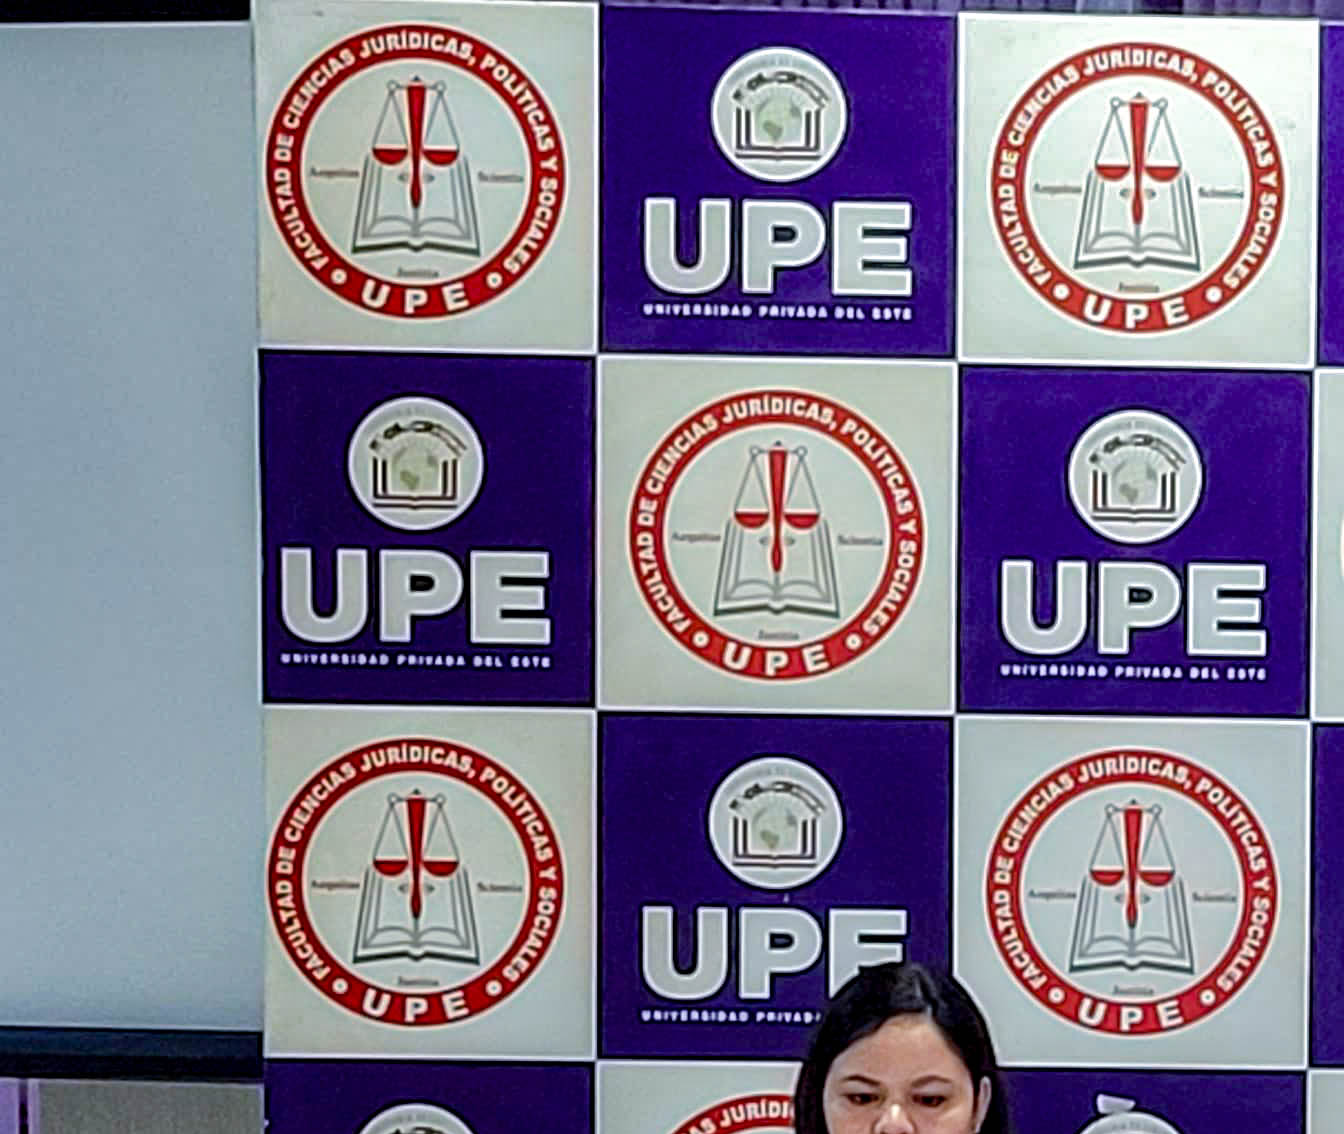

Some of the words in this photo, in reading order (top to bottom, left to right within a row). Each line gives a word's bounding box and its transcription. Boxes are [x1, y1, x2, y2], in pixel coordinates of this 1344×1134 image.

[283, 49, 355, 128] CIENCIAS
[480, 54, 554, 151] POLÍTICAS
[1008, 65, 1080, 146] CIENCIAS
[1202, 70, 1274, 167] POLÍTICAS
[274, 134, 294, 161] DE
[541, 156, 557, 171] Y
[999, 149, 1019, 178] DE
[1260, 172, 1277, 187] Y
[274, 168, 328, 269] FACULTAD
[504, 178, 557, 273] SOCIALES
[646, 198, 911, 295] UPE
[999, 185, 1051, 285] FACULTAD
[1223, 192, 1277, 288] SOCIALES
[362, 280, 468, 313] UPE
[1084, 294, 1189, 328] UPE
[646, 414, 718, 494] CIENCIAS
[840, 419, 913, 514] POLÍTICAS
[637, 498, 657, 526] DE
[900, 519, 916, 533] Y
[282, 549, 550, 643] UPE
[637, 532, 691, 632] FACULTAD
[863, 540, 916, 635] SOCIALES
[1002, 561, 1266, 655] UPE
[724, 642, 829, 676] UPE
[285, 763, 356, 841] CIENCIAS
[480, 767, 553, 861] POLÍTICAS
[1003, 773, 1074, 852] CIENCIAS
[1195, 778, 1266, 872] POLÍTICAS
[276, 847, 296, 874] DE
[539, 867, 556, 880] Y
[994, 856, 1014, 884] DE
[1253, 876, 1270, 890] Y
[276, 880, 330, 979] FACULTAD
[503, 887, 556, 981] SOCIALES
[994, 890, 1047, 989] FACULTAD
[1217, 896, 1270, 991] SOCIALES
[363, 989, 468, 1022] UPE
[1079, 998, 1183, 1031] UPE
